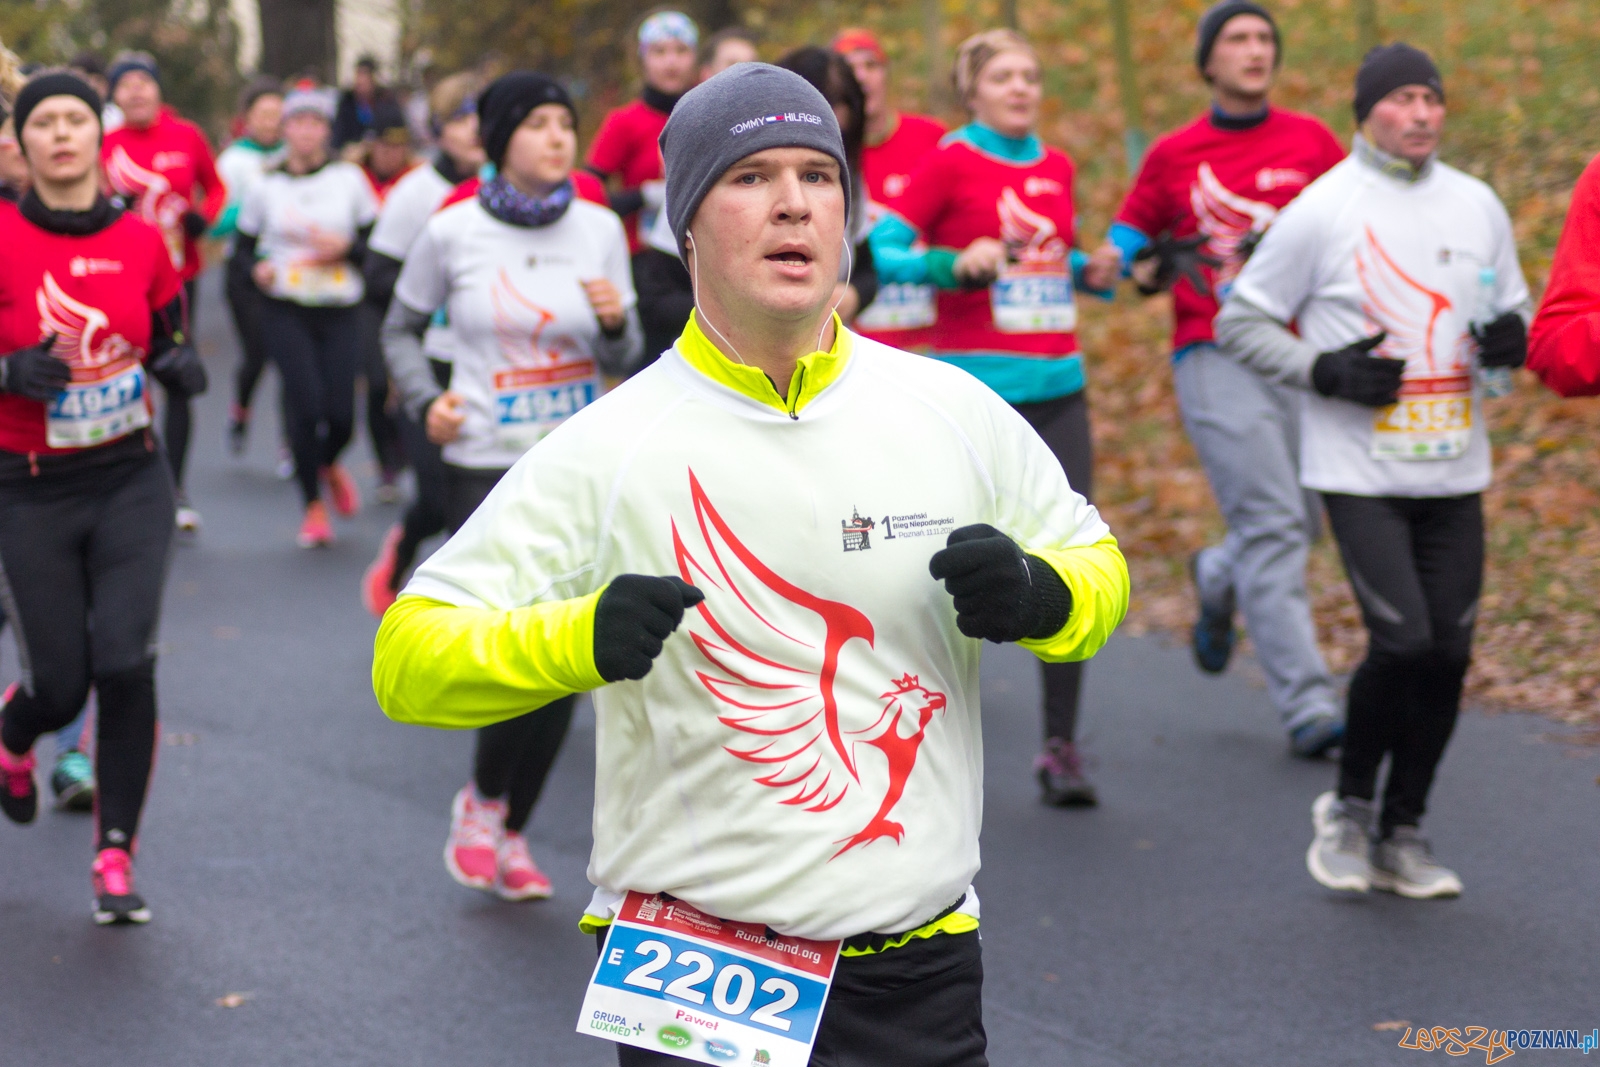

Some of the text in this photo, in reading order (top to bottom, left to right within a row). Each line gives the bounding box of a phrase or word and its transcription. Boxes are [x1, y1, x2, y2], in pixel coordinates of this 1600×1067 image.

[729, 112, 822, 136] TOMMY HILFIGER
[61, 376, 135, 416] 4947
[1387, 401, 1464, 429] 4352
[892, 512, 927, 523] Poznański
[893, 516, 955, 531] Bieg Niepodległości
[881, 516, 896, 540] 1
[663, 905, 675, 921] 1
[675, 907, 701, 919] Poznański
[735, 929, 822, 964] RunPoland.org
[607, 939, 800, 1032] E 2202
[590, 1019, 631, 1037] LUXMED
[593, 1010, 627, 1026] GRUPA
[675, 1009, 719, 1031] Paweł
[662, 1033, 689, 1046] energy
